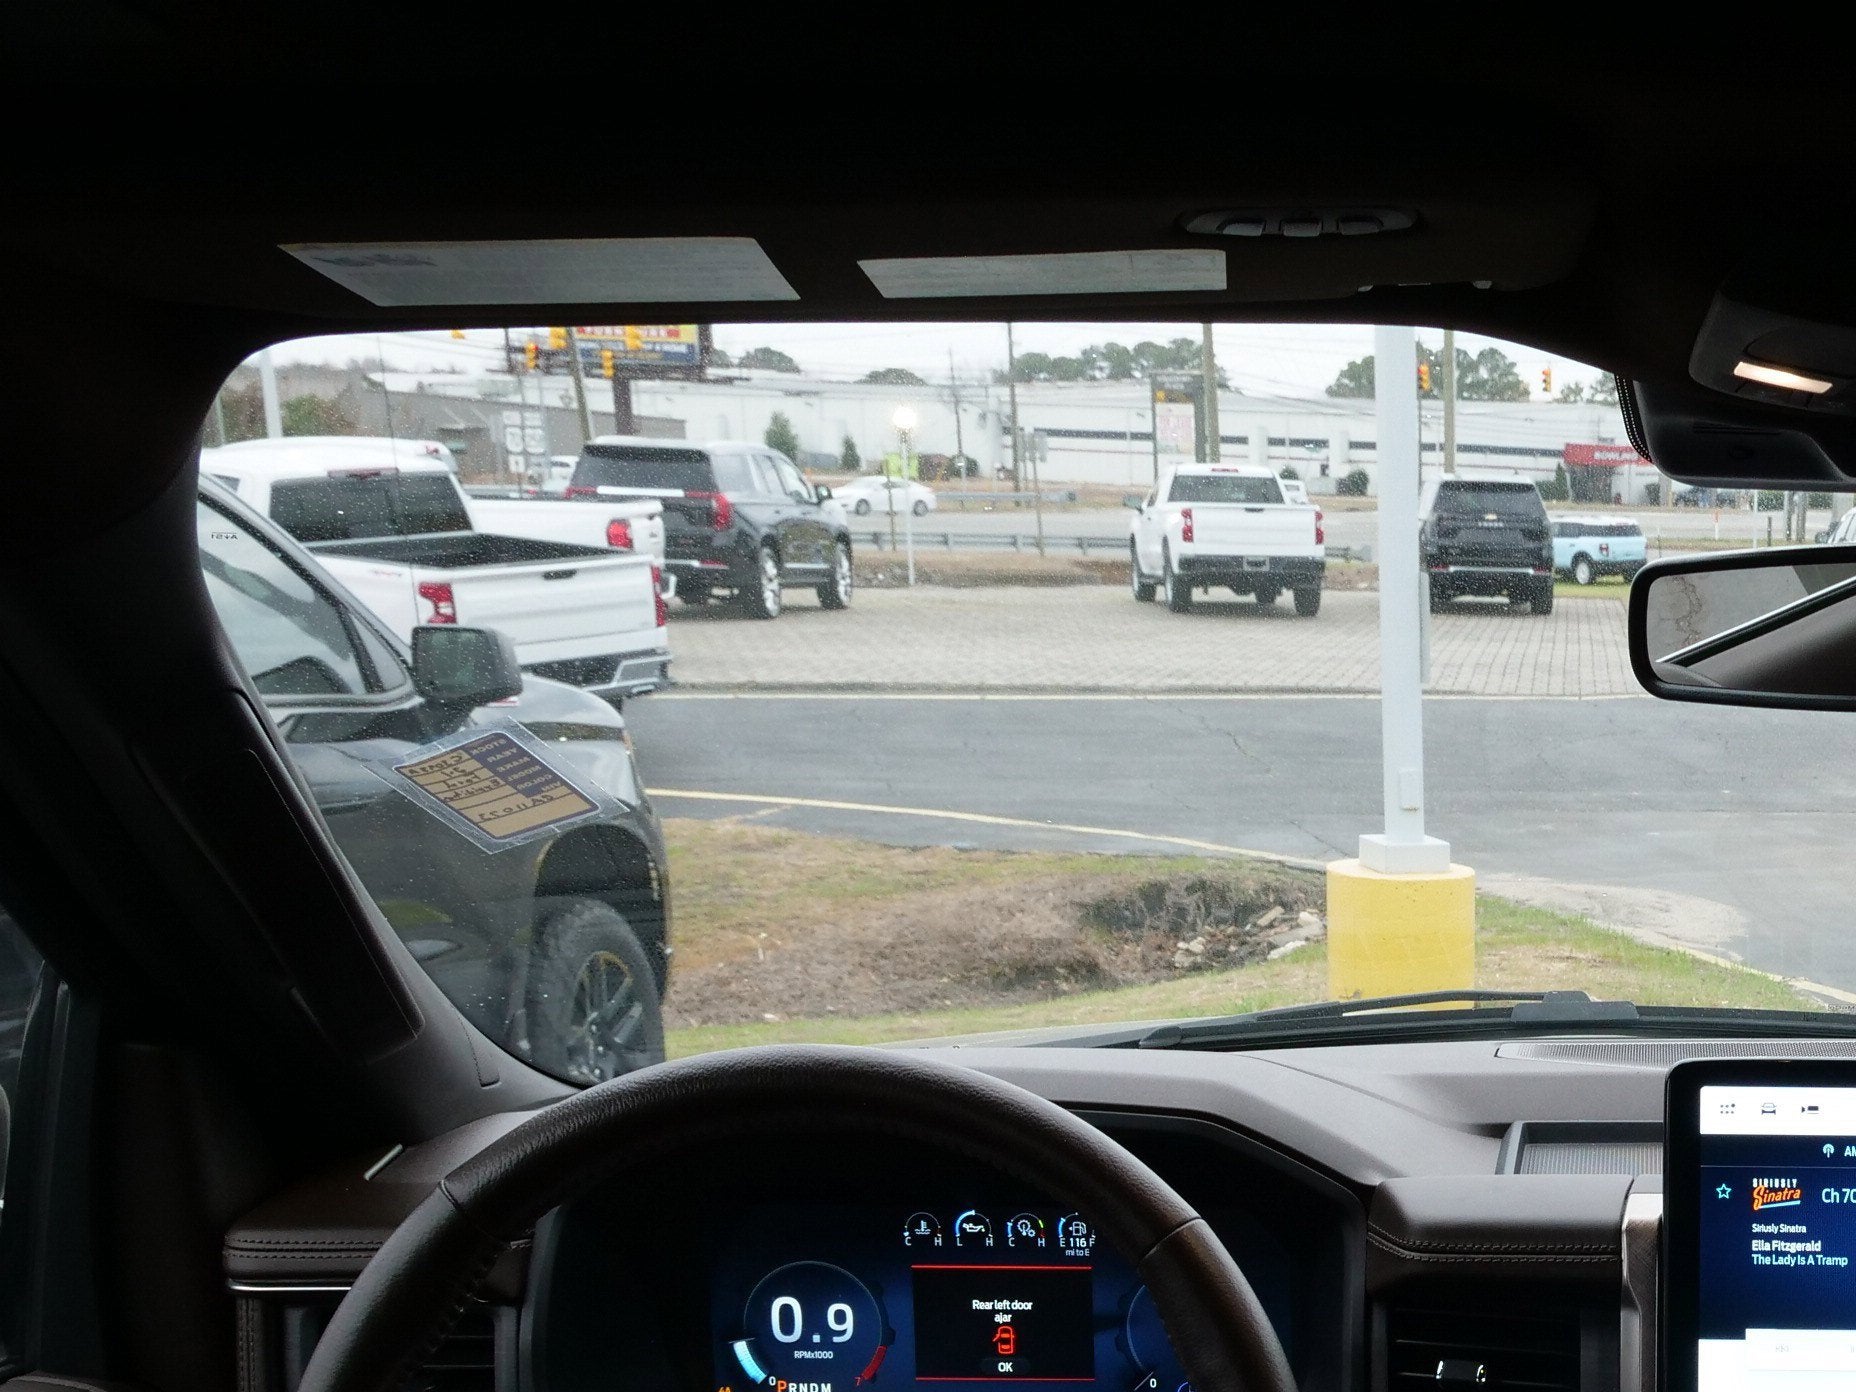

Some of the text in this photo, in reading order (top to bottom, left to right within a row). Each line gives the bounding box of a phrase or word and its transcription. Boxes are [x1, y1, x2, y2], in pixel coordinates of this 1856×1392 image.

[1752, 1185, 1801, 1210] Sinatra
[1821, 1188, 1840, 1204] Ch
[1779, 1223, 1807, 1233] Sinatra
[1069, 1237, 1088, 1248] 116
[1752, 1240, 1822, 1253] Ella Fitzgerald
[1065, 1248, 1075, 1257] mi
[1752, 1254, 1849, 1268] The Lady Is A Tramp
[972, 1299, 1033, 1311] Rear left door
[770, 1295, 855, 1344] 0.9
[994, 1312, 1012, 1324] ajar
[793, 1350, 834, 1360] RPMx1000
[997, 1361, 1013, 1373] OK
